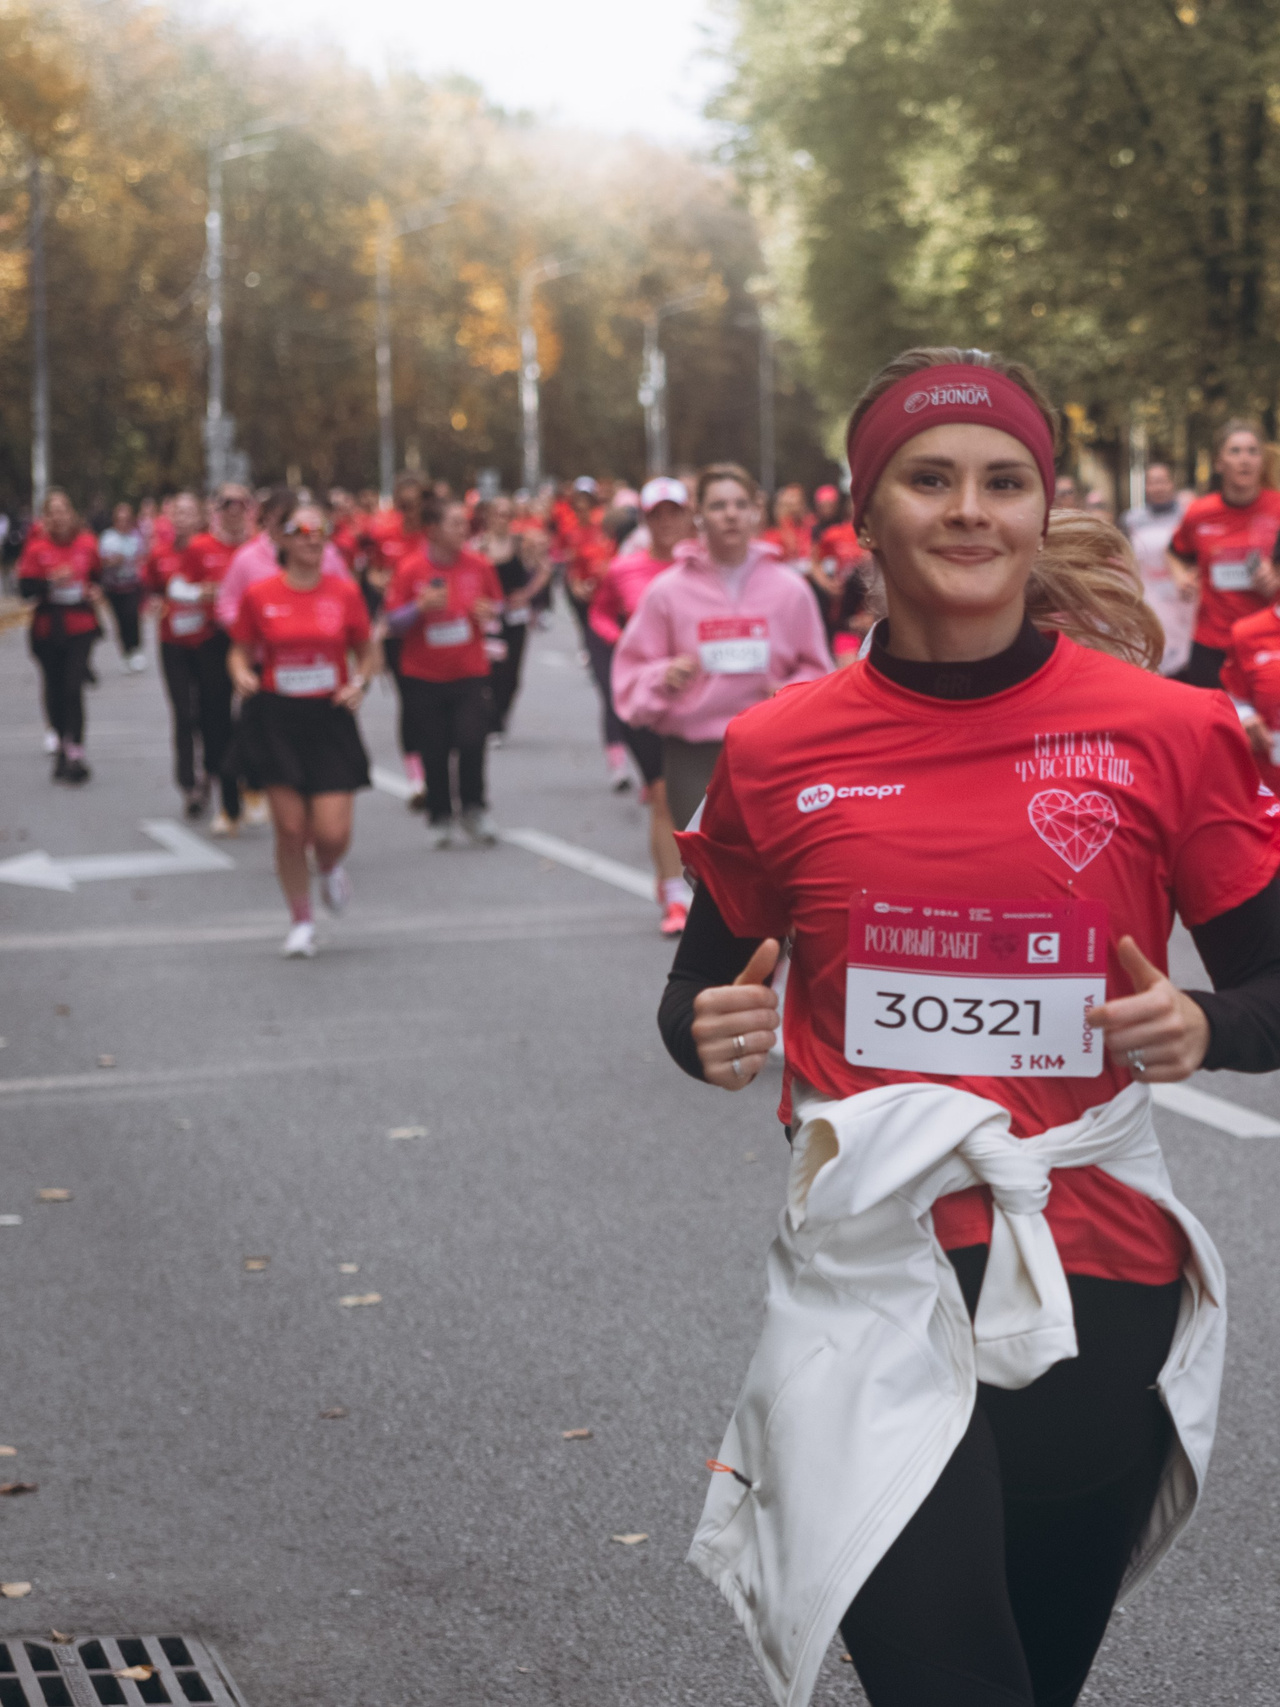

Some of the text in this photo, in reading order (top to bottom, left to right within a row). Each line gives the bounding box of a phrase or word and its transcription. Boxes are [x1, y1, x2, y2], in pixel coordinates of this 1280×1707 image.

[931, 387, 992, 408] WONDER
[1015, 755, 1134, 787] ЧУВСТВУЕШЬ
[836, 784, 905, 800] спорт
[864, 924, 982, 961] РОЗОВЫЙ ЗАБЕГ
[874, 991, 1041, 1036] 30321
[1082, 994, 1095, 1053] МОСВА
[1011, 1054, 1023, 1069] 3
